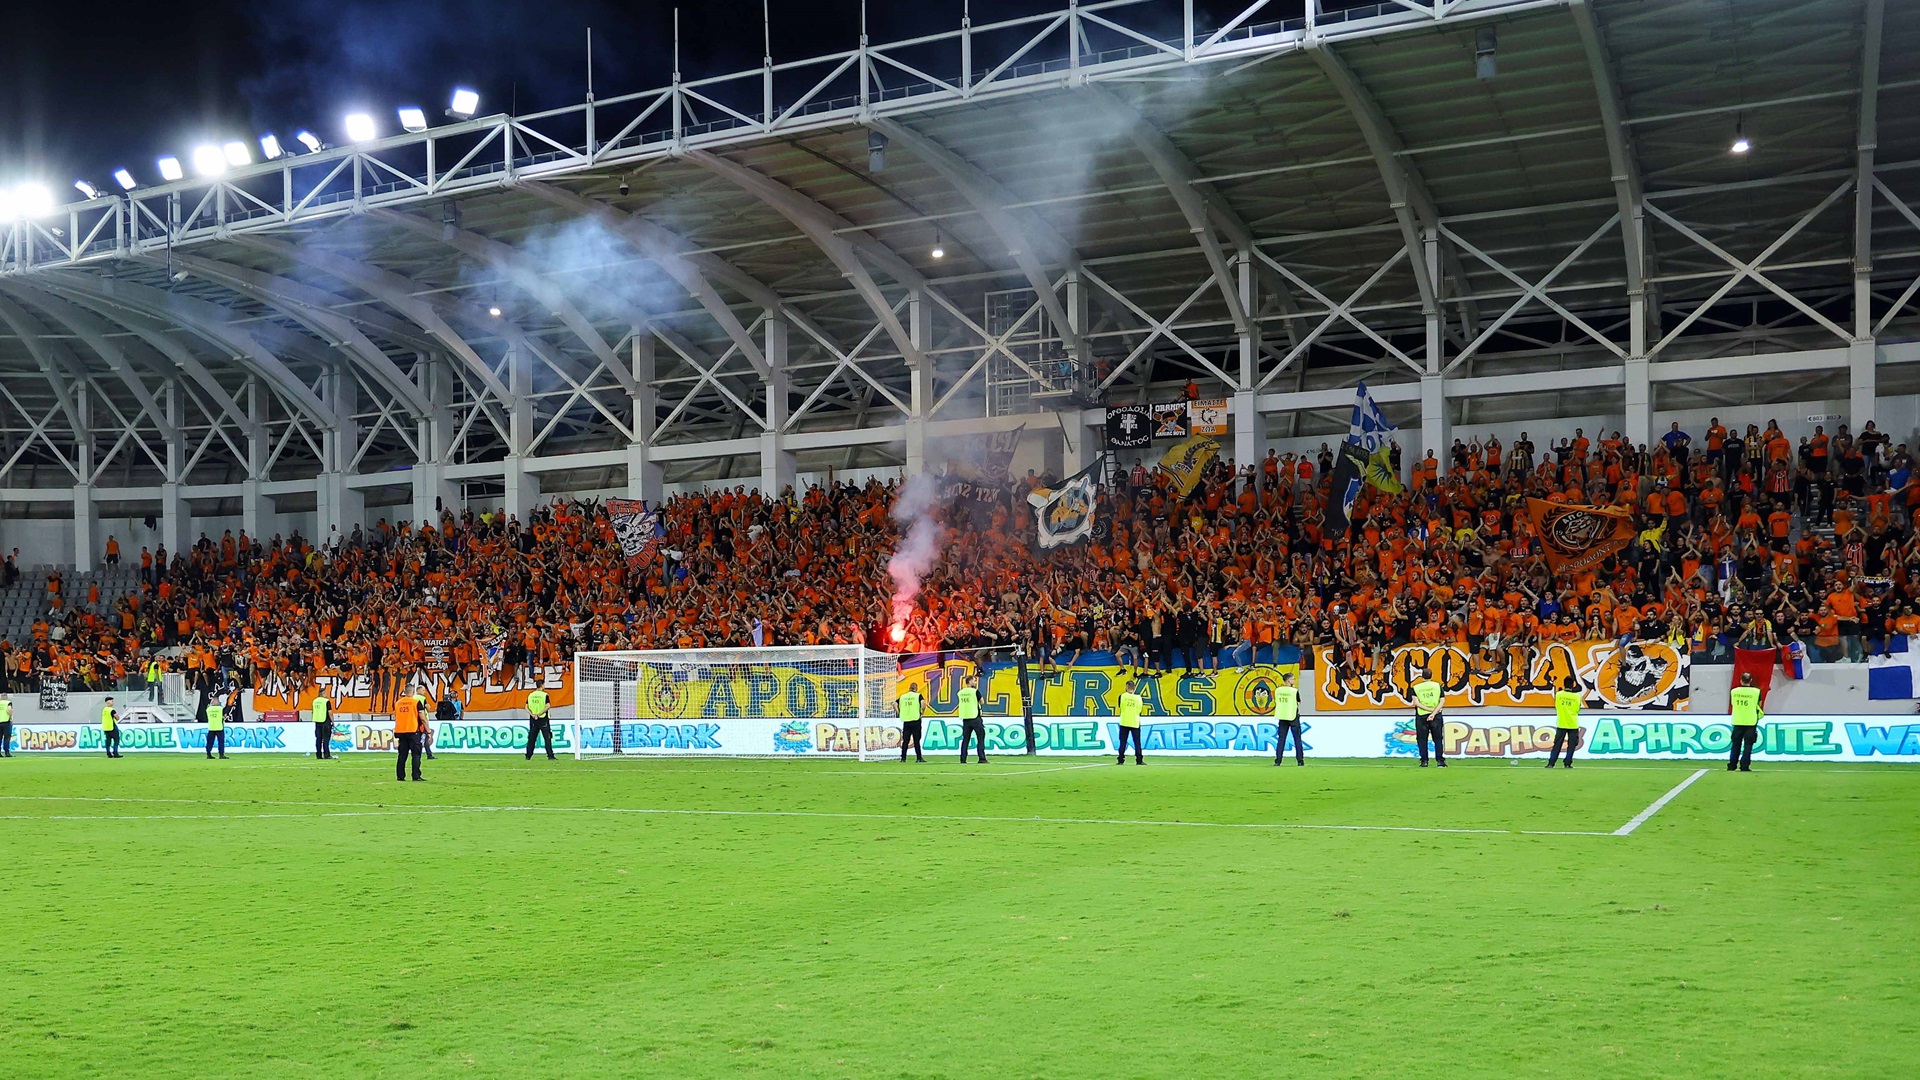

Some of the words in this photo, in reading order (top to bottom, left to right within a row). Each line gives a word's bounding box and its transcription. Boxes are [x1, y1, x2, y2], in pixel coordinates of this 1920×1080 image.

[423, 639, 449, 647] WATCH
[315, 674, 370, 710] TIME
[700, 671, 897, 719] APOEL
[924, 664, 1217, 716] ULTRAS
[20, 728, 77, 749] PAPHOS
[1443, 721, 1587, 756] PAPHO
